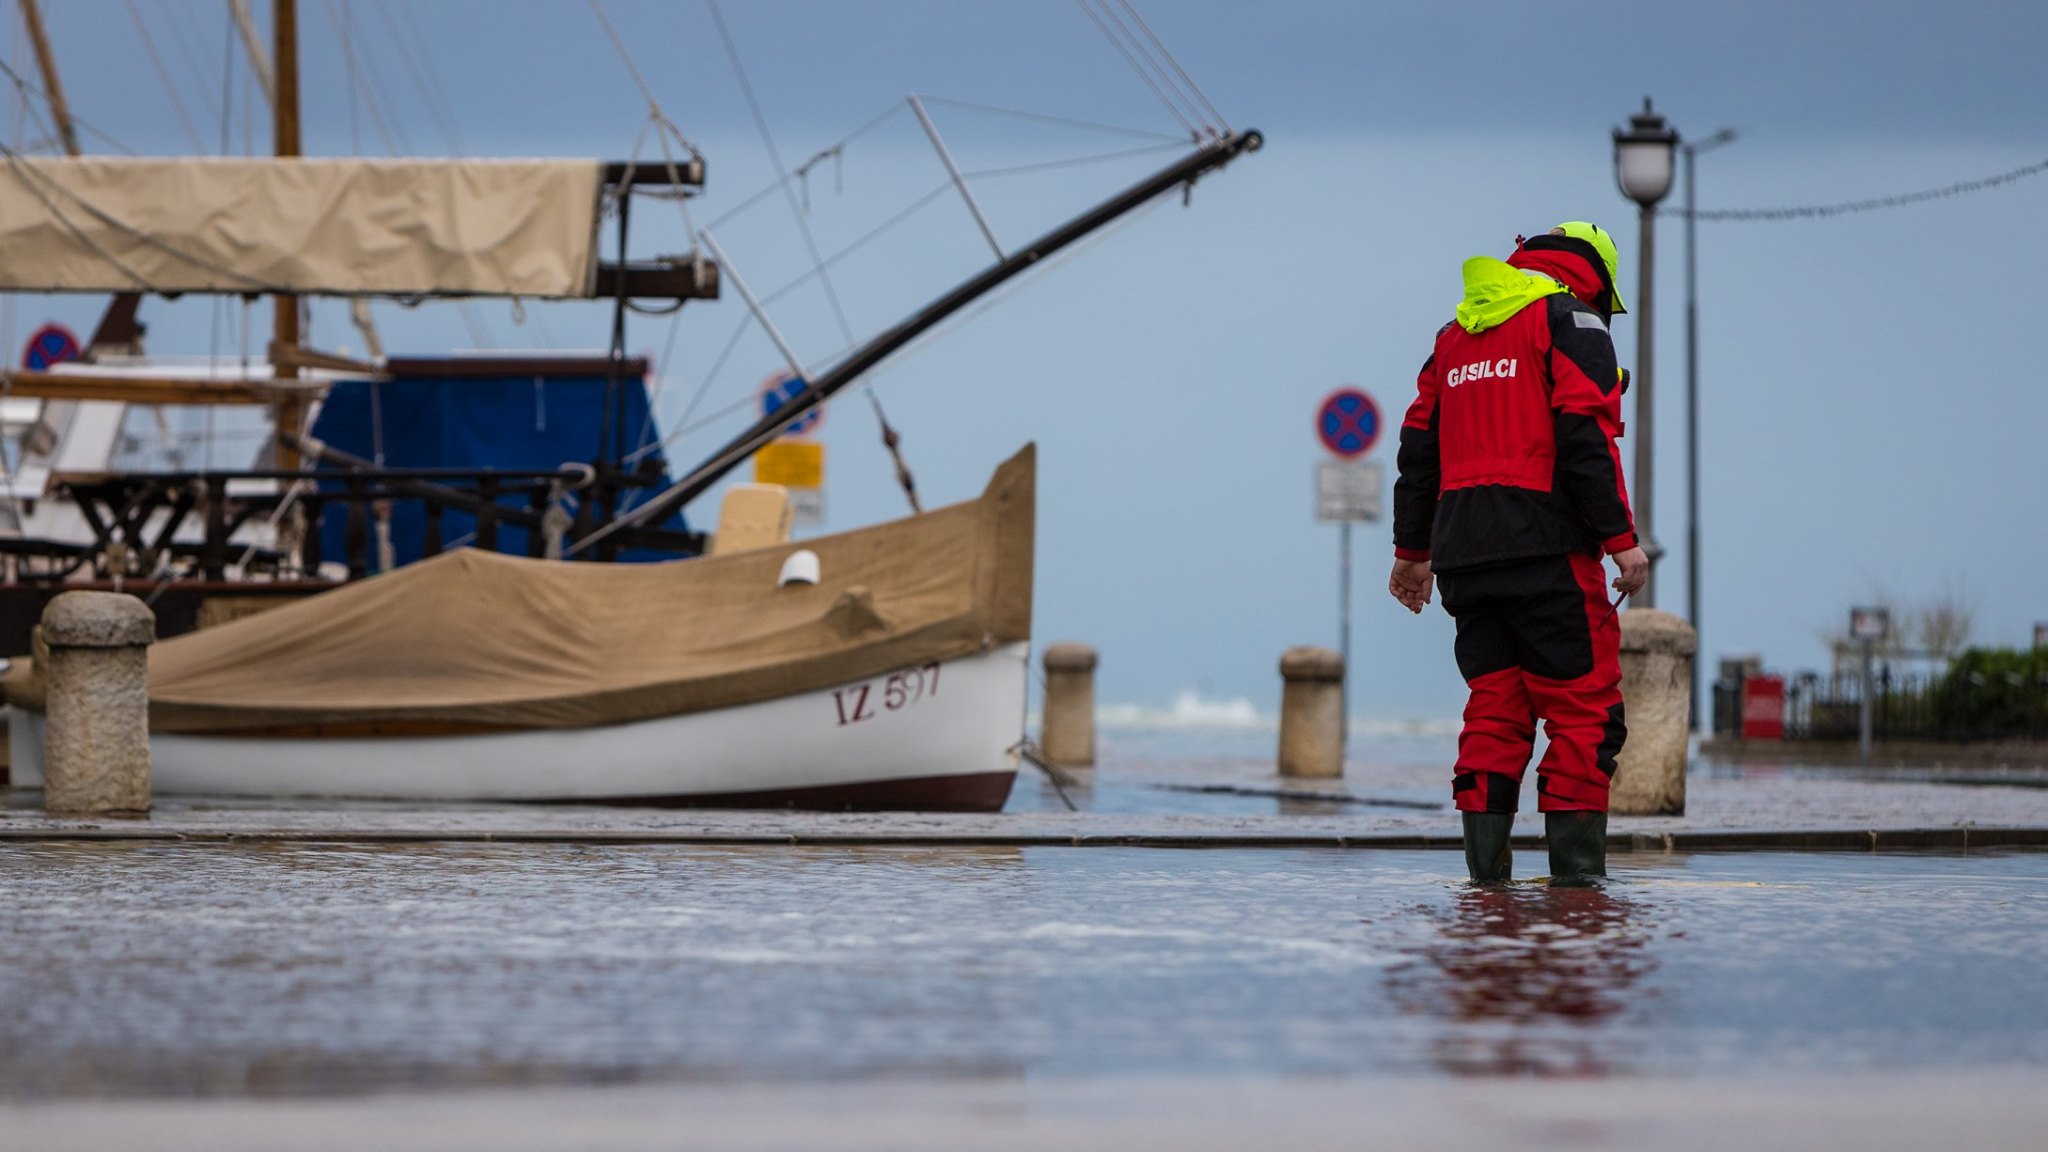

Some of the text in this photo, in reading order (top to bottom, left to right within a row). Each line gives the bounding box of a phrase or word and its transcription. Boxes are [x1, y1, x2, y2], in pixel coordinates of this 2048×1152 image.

[1447, 358, 1517, 388] GASILCI
[832, 660, 940, 727] IZ 597
